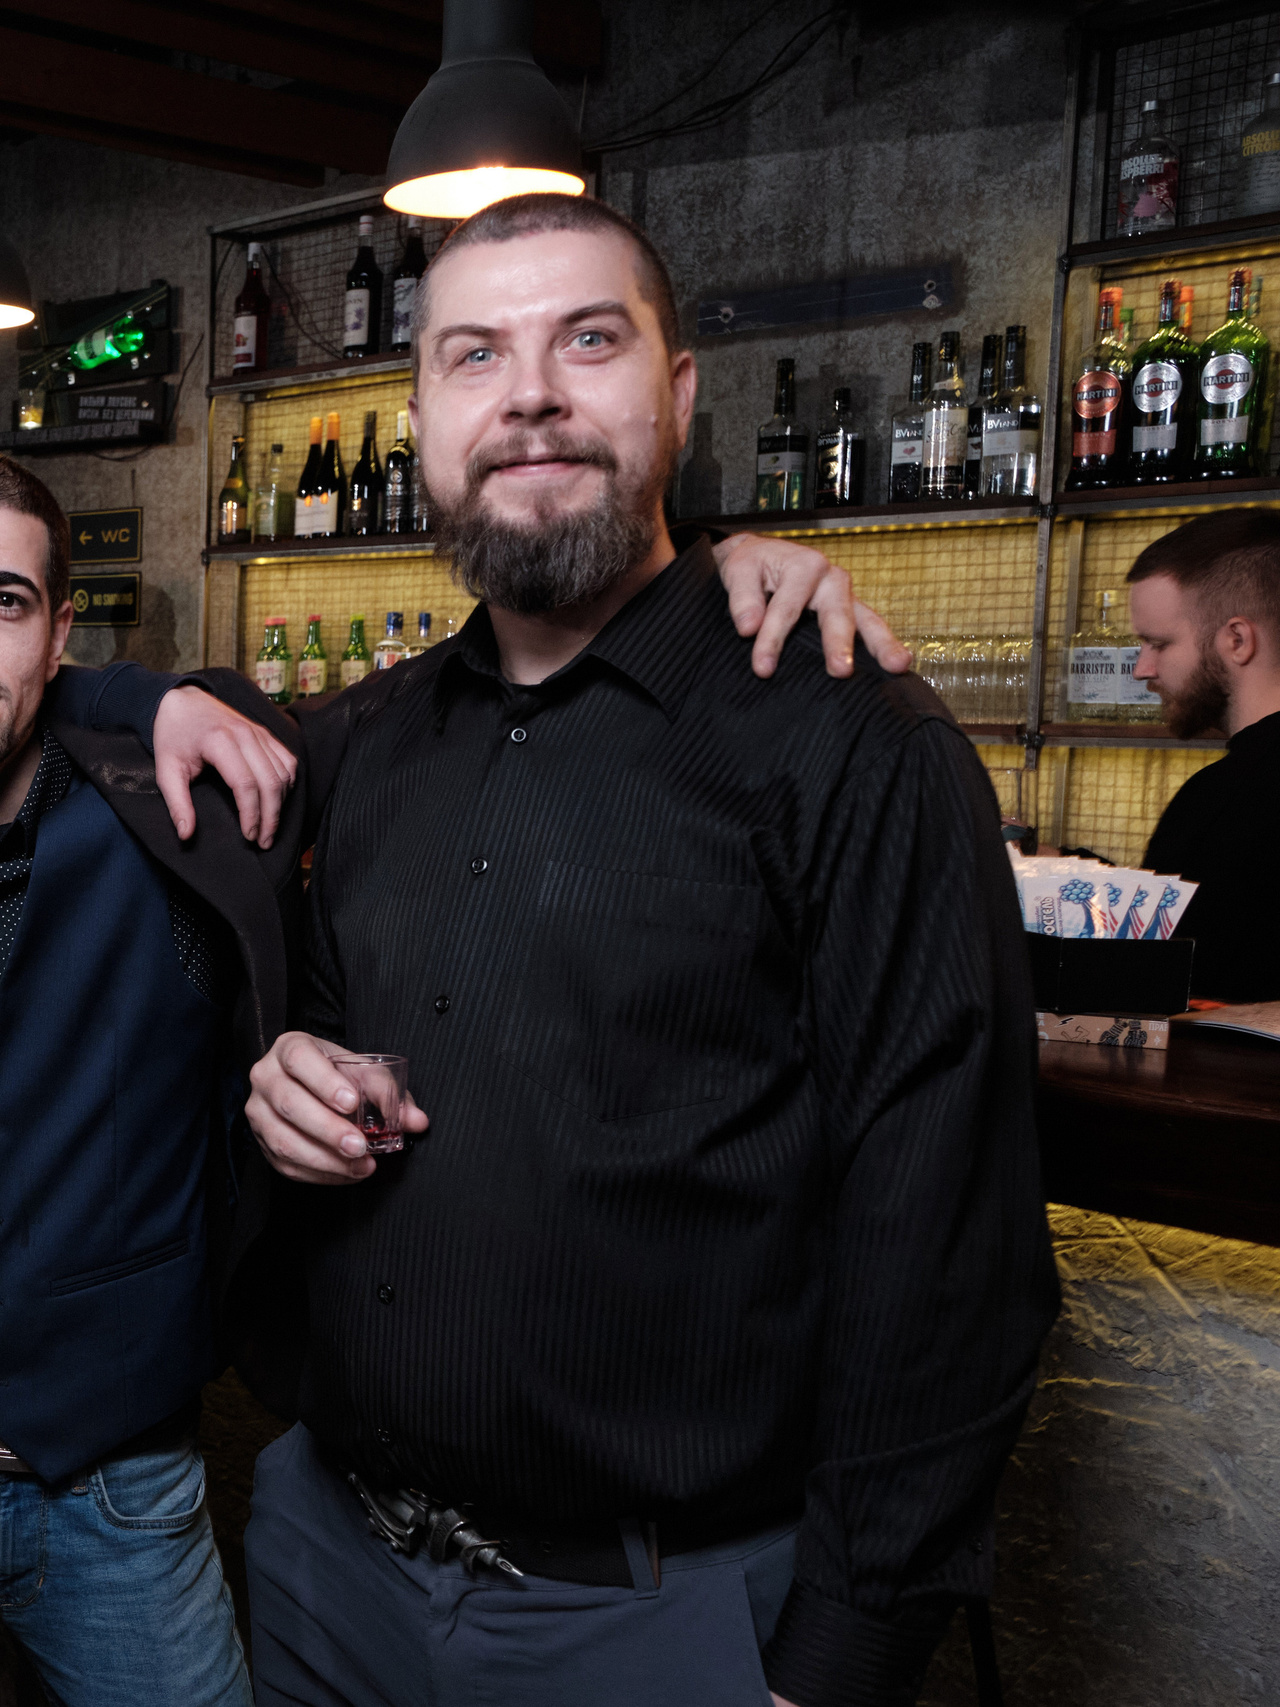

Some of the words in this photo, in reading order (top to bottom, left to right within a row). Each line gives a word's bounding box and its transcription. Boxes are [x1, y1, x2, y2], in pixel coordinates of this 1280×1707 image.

[1204, 372, 1250, 387] MARTINI
[1076, 388, 1117, 401] MARTINI
[1134, 380, 1179, 396] MARTINI
[101, 527, 131, 543] WC
[1071, 662, 1115, 675] BARRISTER
[1039, 896, 1056, 936] ОСГЕЛЬ
